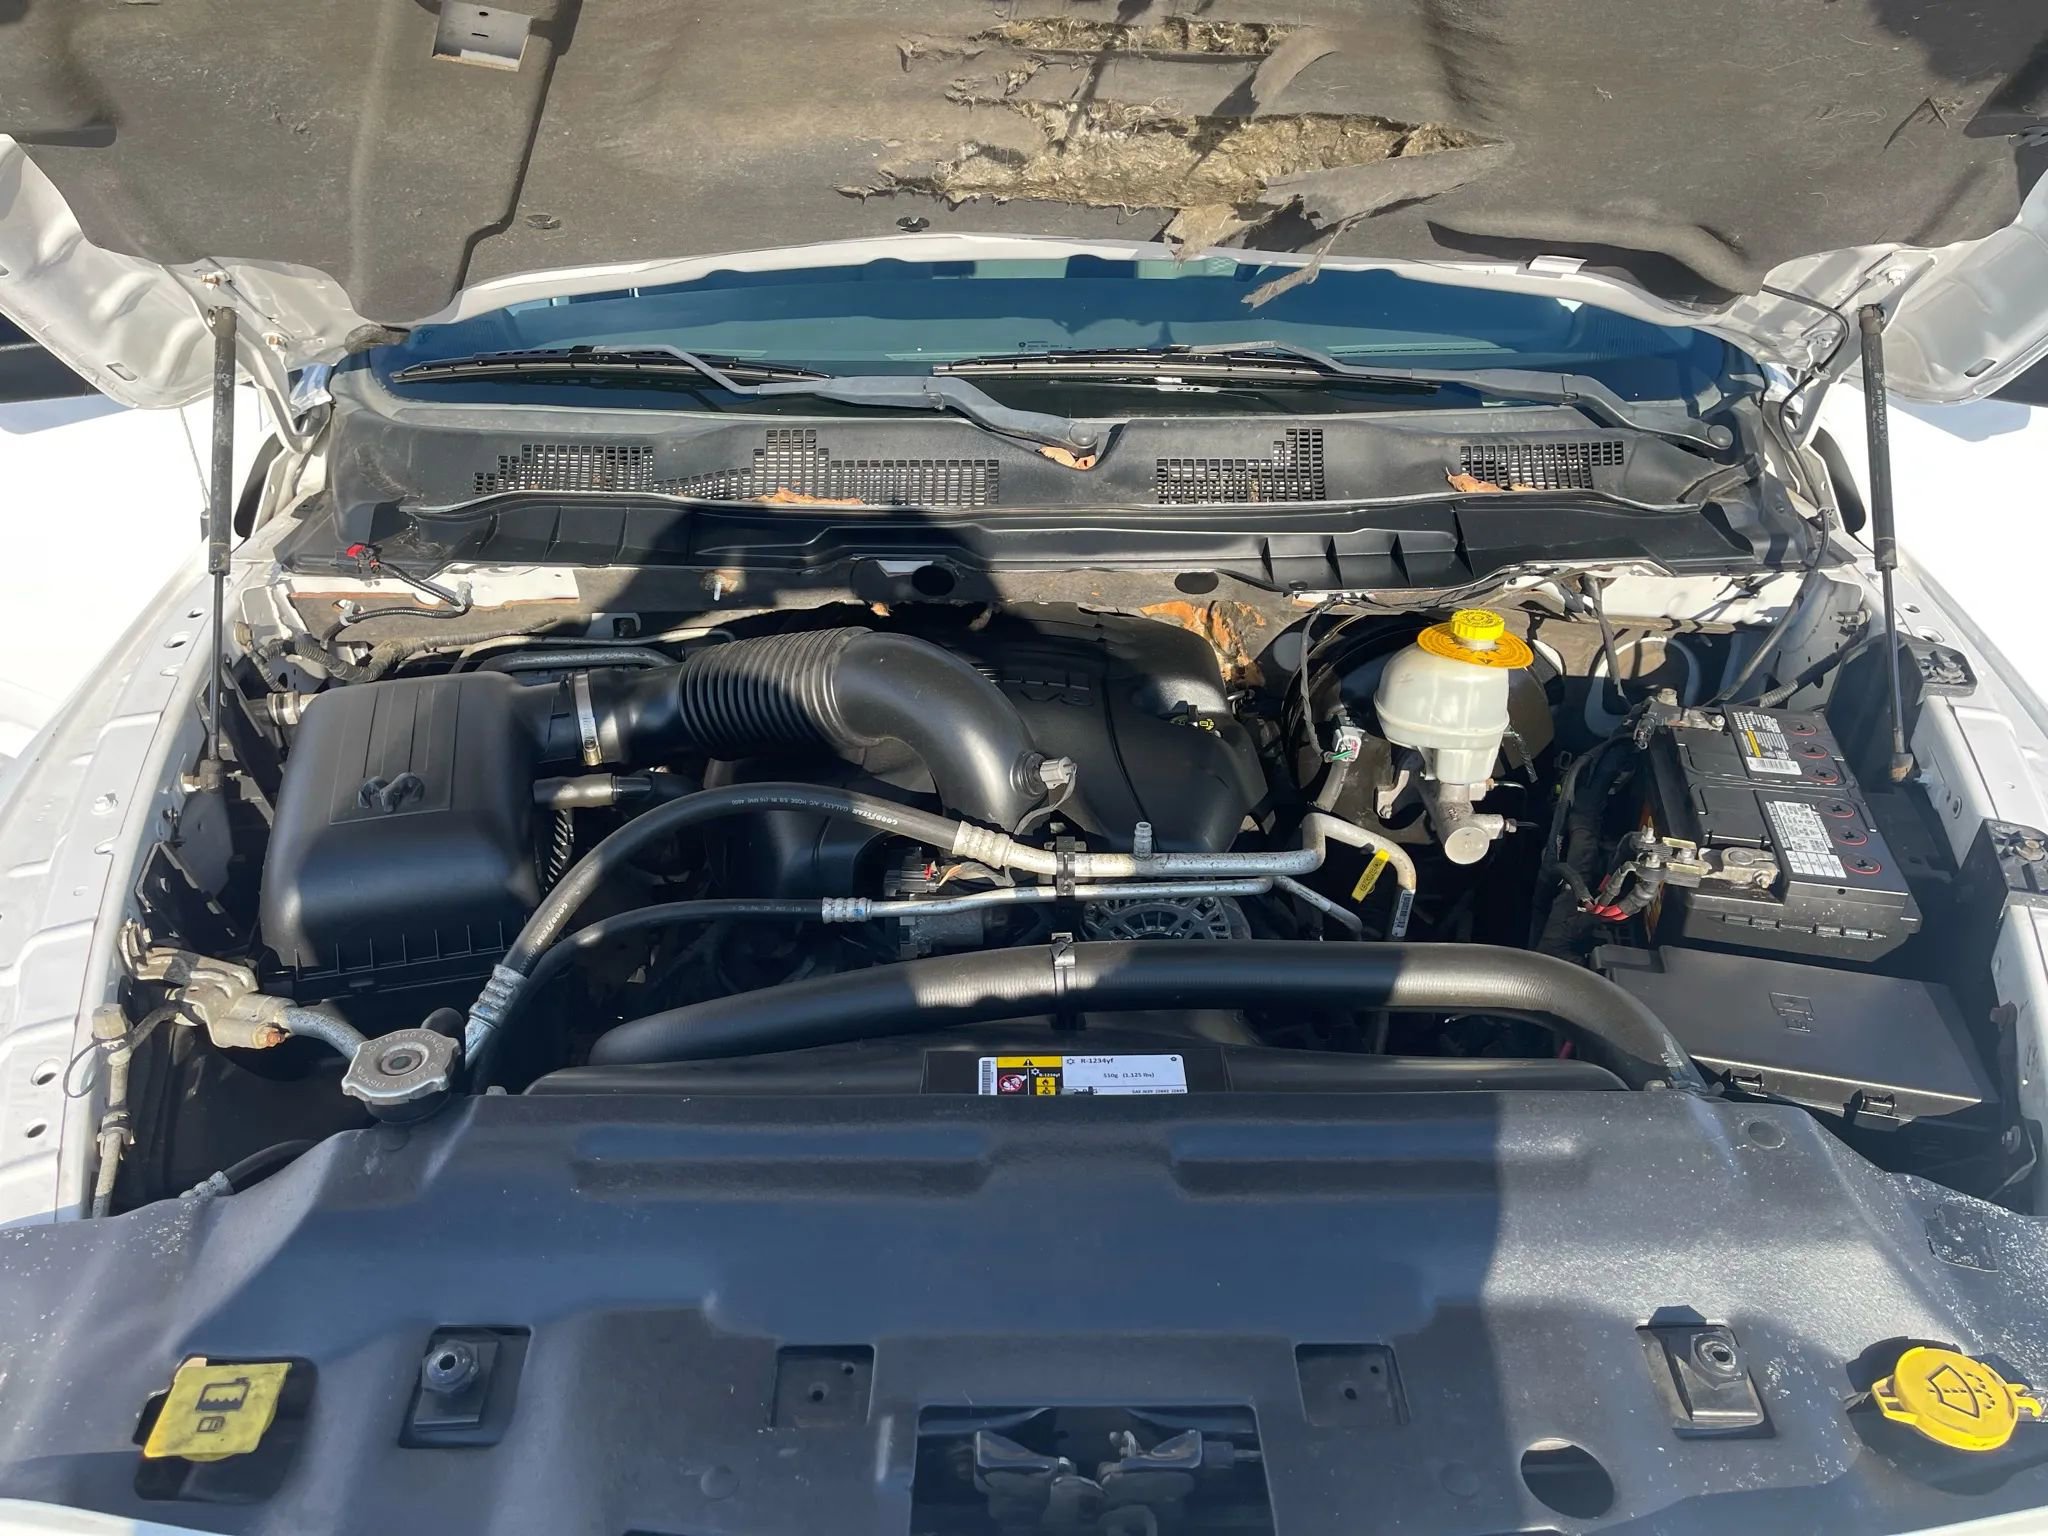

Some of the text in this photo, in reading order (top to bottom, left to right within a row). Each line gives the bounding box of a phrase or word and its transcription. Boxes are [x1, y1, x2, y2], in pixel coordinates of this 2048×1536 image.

[822, 802, 849, 812] GALAXY
[852, 807, 898, 825] GOODYEAR
[535, 902, 568, 946] GOODYEAR
[1080, 1057, 1114, 1065] R-1234yf
